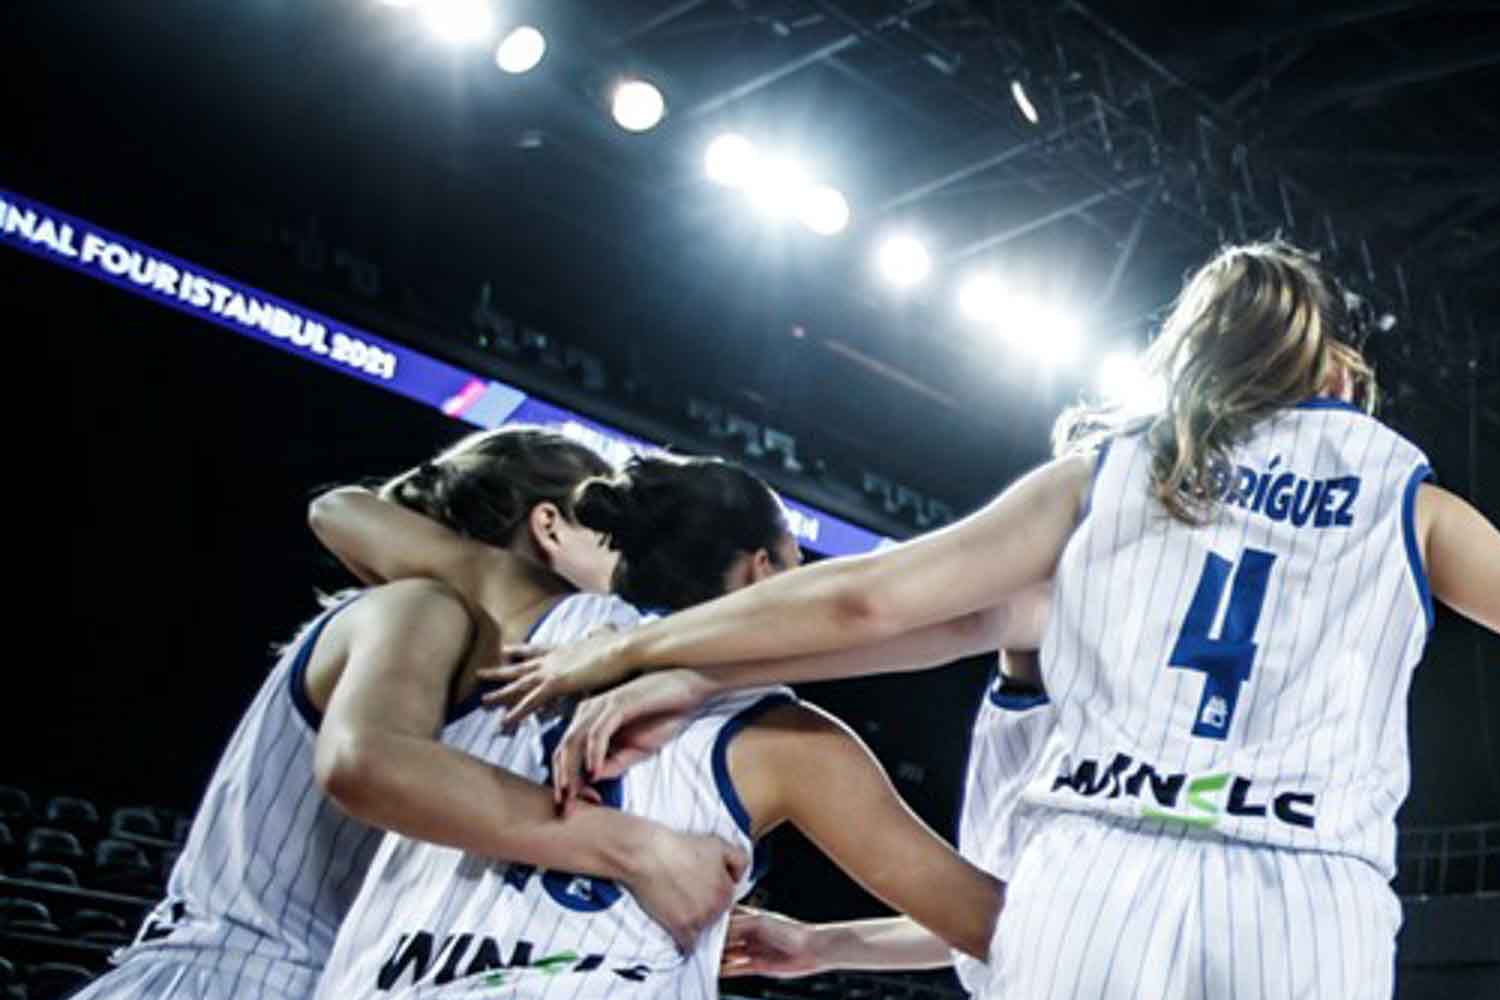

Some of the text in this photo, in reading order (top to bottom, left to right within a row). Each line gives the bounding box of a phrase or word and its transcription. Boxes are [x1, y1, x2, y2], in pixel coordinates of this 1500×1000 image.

[80, 232, 180, 295] FOUR
[179, 272, 328, 355] ISTANBUL
[330, 332, 397, 379] 2021
[1167, 547, 1277, 741] 4
